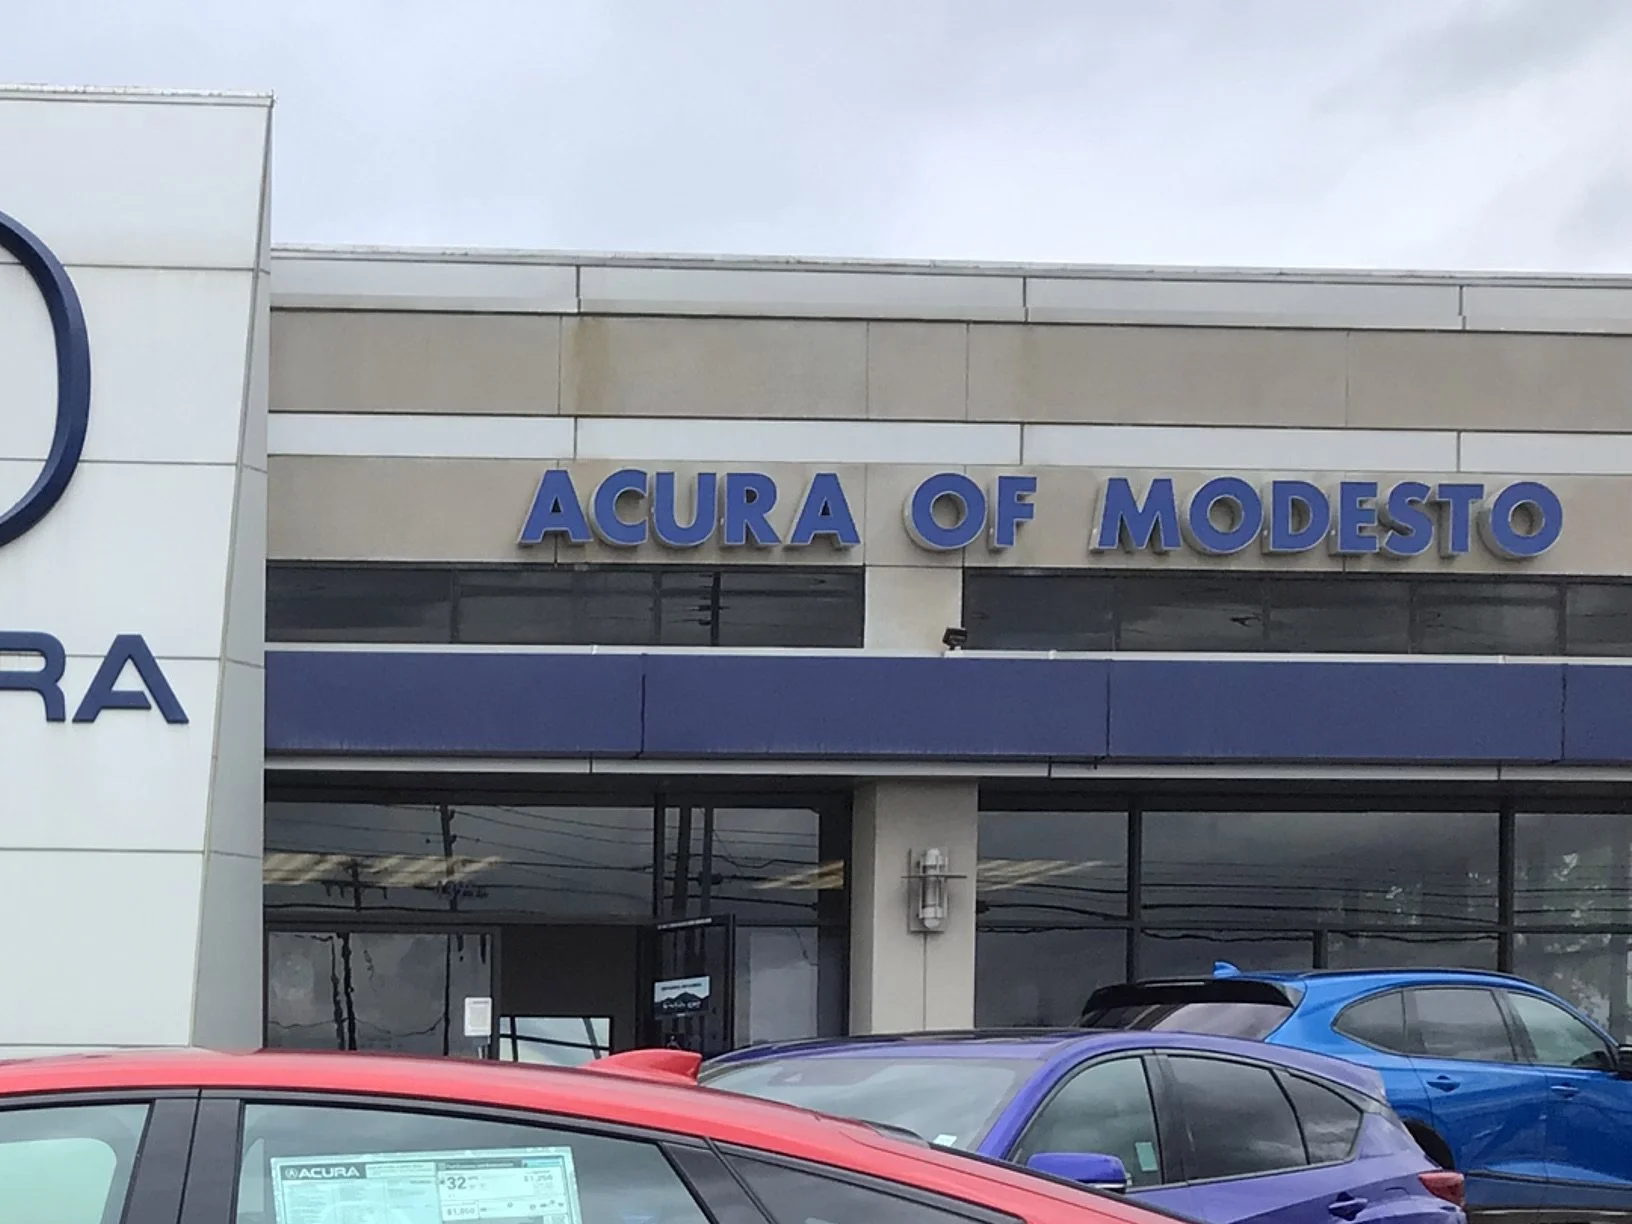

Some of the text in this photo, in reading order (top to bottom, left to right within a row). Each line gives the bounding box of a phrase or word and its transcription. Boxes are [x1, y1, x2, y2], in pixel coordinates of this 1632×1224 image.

[518, 468, 1564, 560] ACURA OF MODESTO
[298, 1165, 361, 1180] ACURA
[446, 1176, 467, 1191] 32
